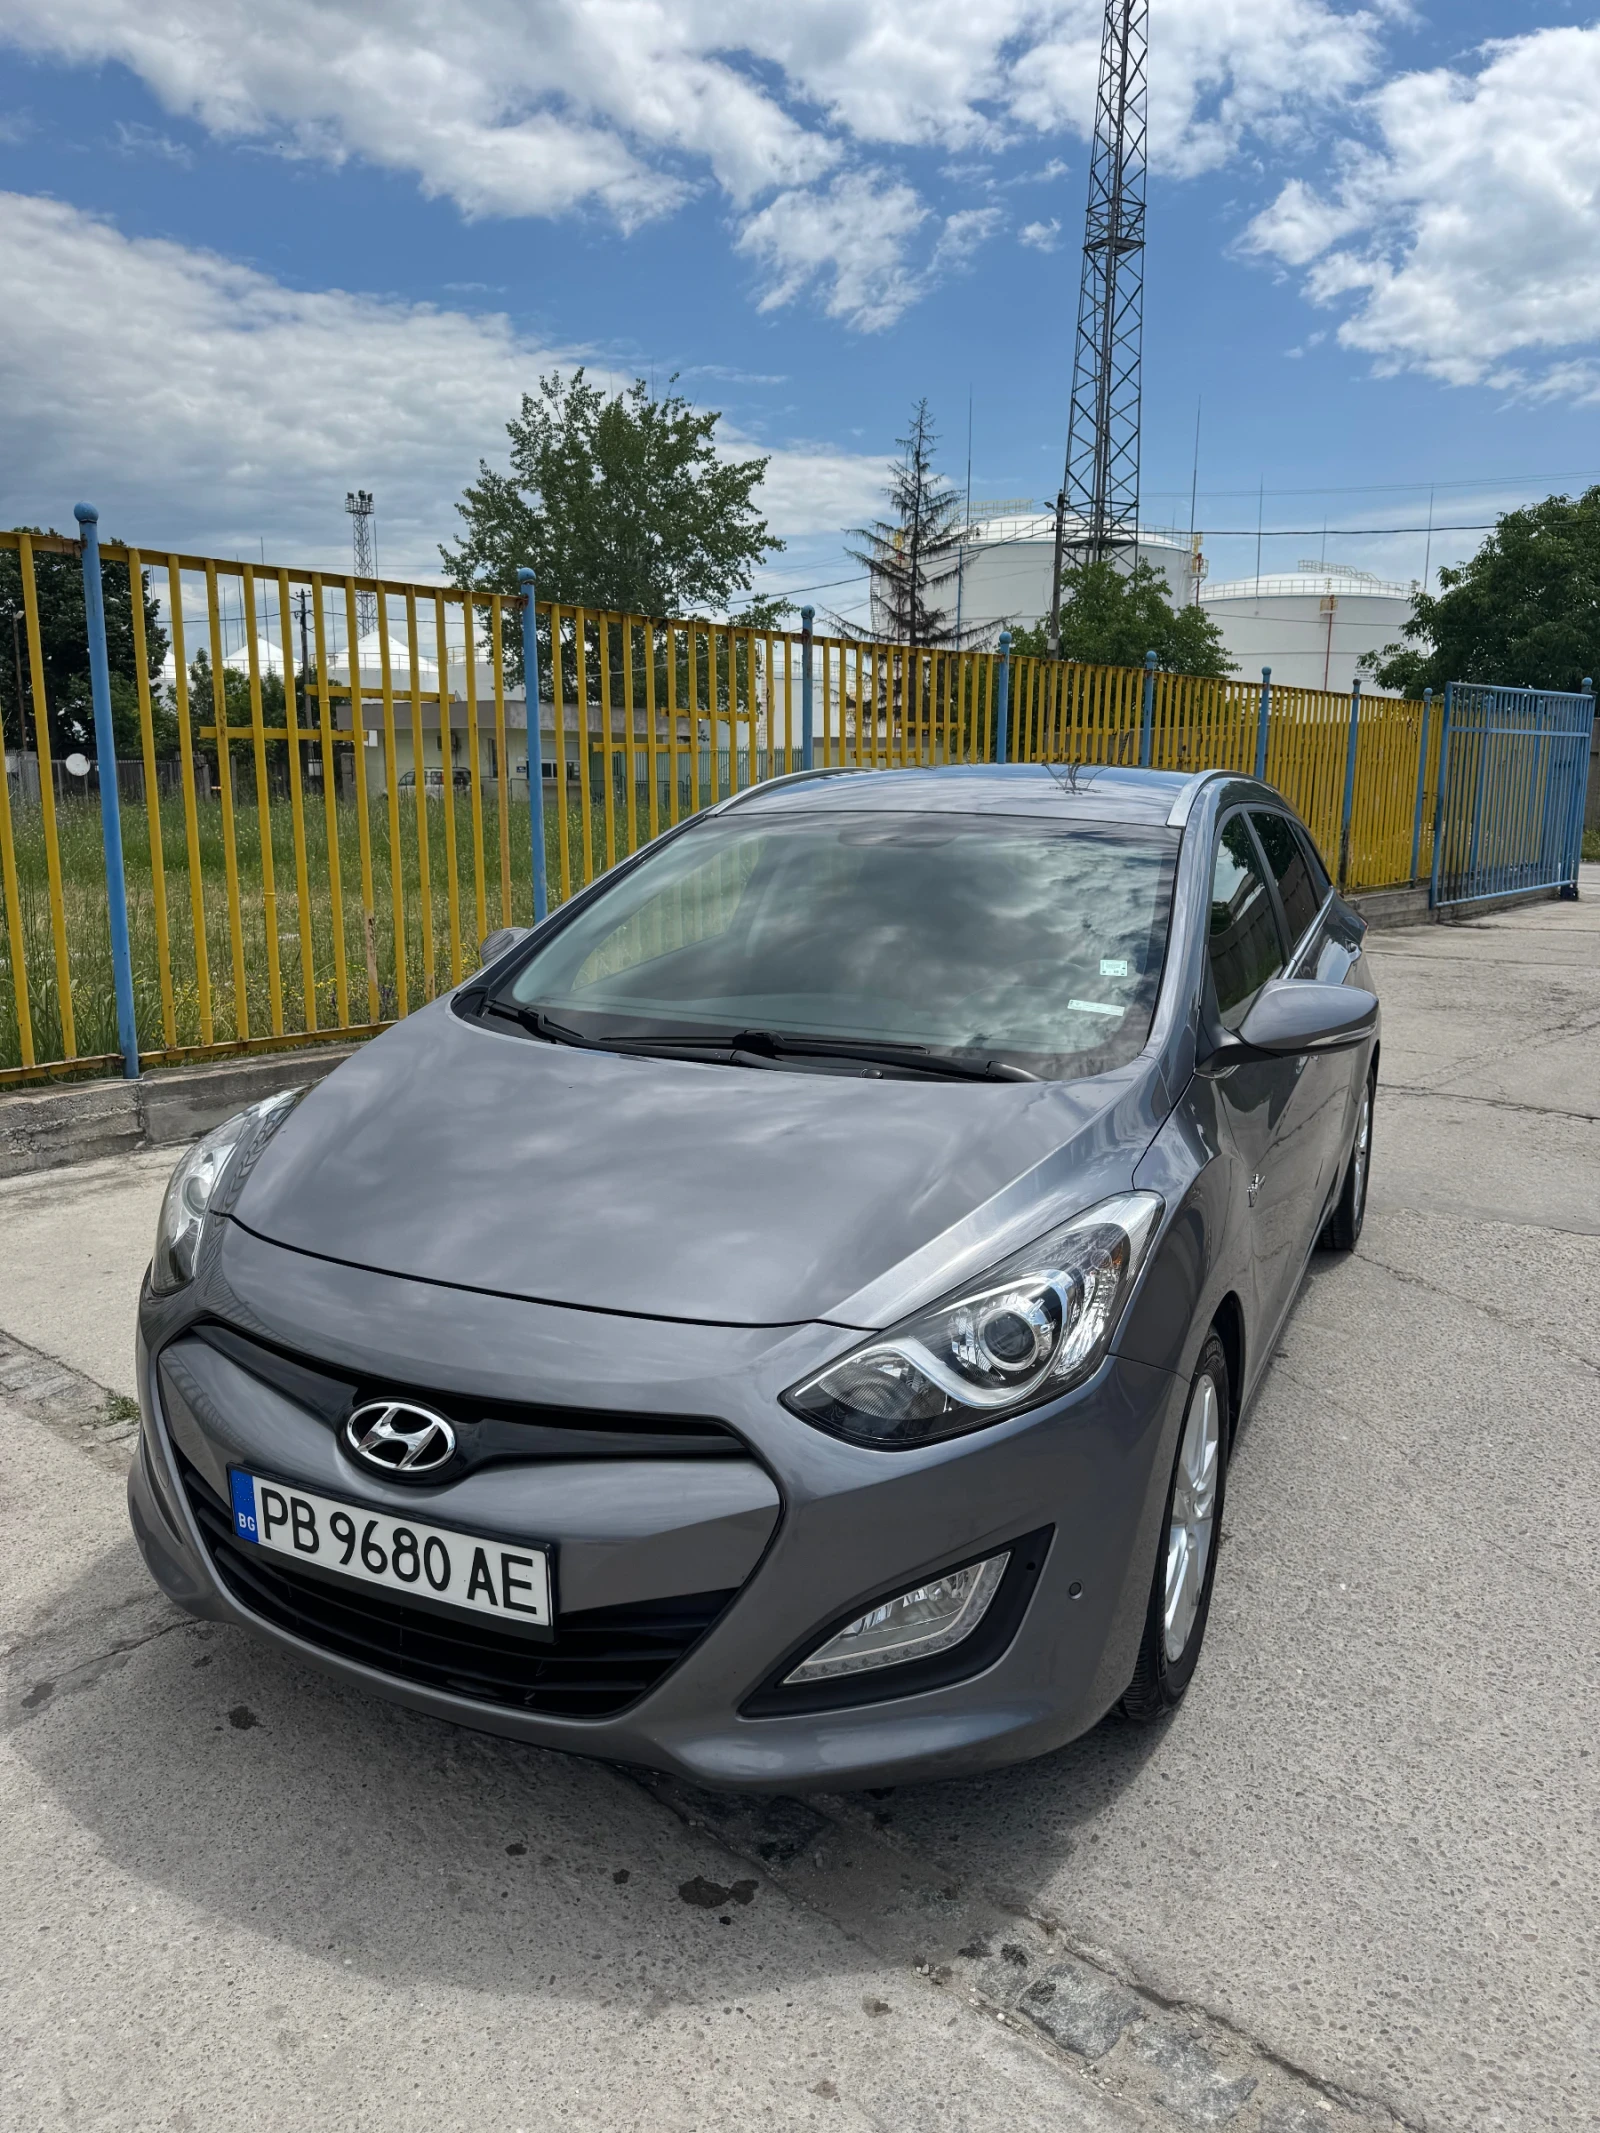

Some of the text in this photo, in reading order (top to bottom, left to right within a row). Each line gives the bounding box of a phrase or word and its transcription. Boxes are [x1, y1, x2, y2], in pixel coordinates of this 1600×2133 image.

[238, 1512, 256, 1532] BG
[261, 1487, 537, 1615] PB 9680 AE
